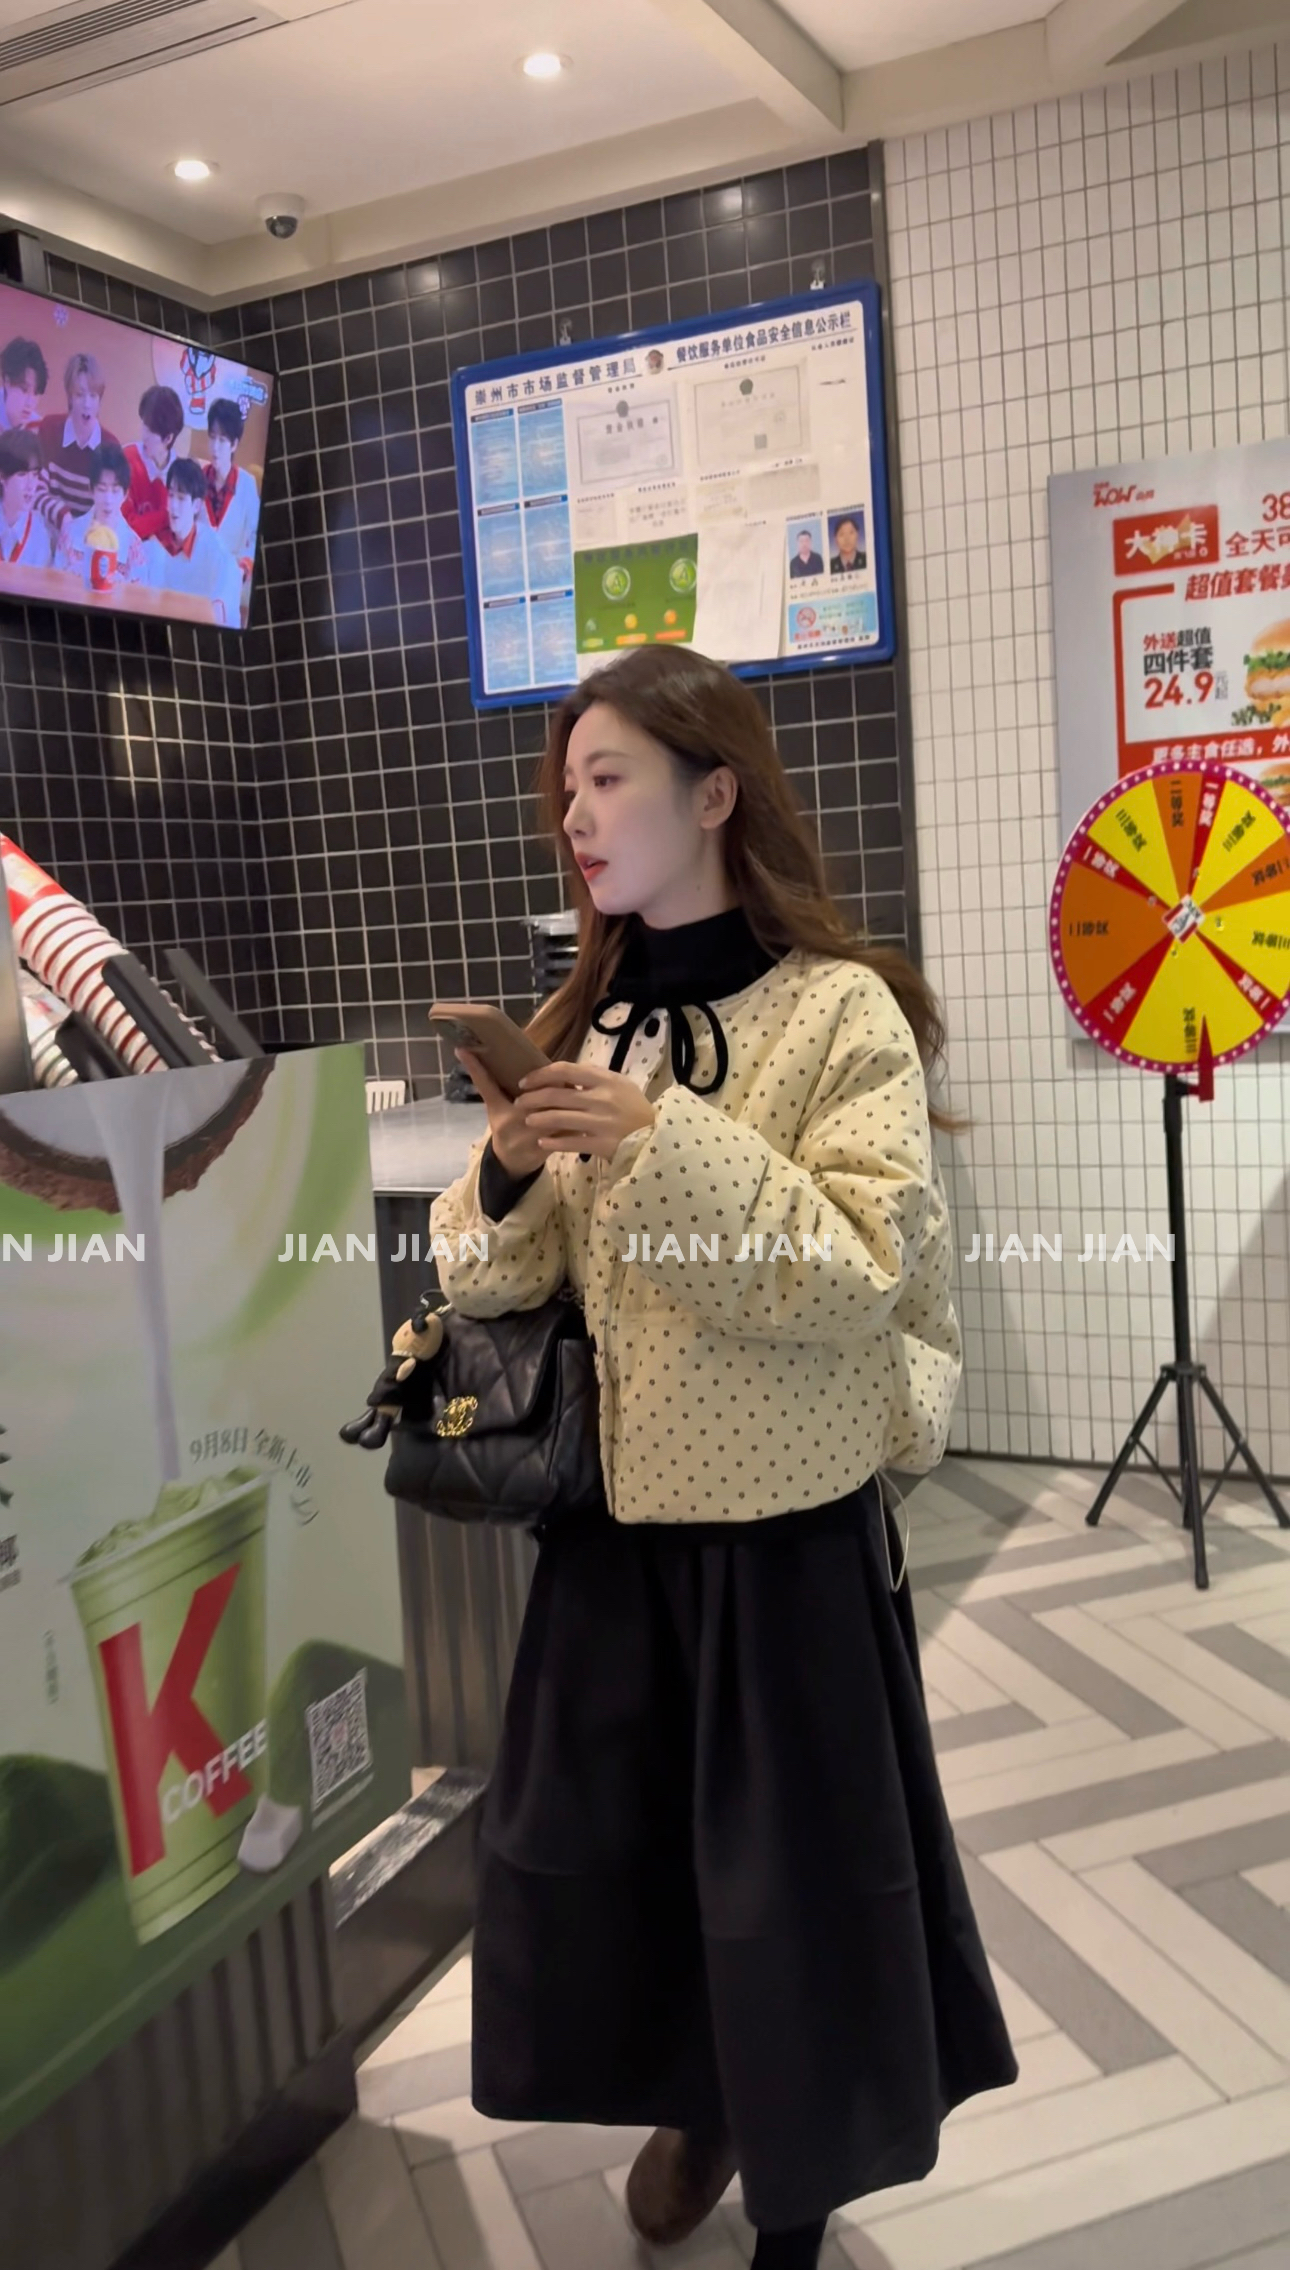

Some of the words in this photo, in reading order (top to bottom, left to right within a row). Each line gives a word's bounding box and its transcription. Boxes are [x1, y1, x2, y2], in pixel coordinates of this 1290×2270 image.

[676, 311, 852, 363] 餐饮服务单位食品安全信息公示栏
[475, 357, 636, 405] 崇州市市场监督管理局
[1262, 491, 1290, 522] 38
[1143, 626, 1212, 651] 外送超值
[1143, 647, 1214, 676] 四件套
[1144, 671, 1214, 709] 24.9
[98, 1562, 242, 1878] K
[161, 1718, 267, 1825] COFFEE
